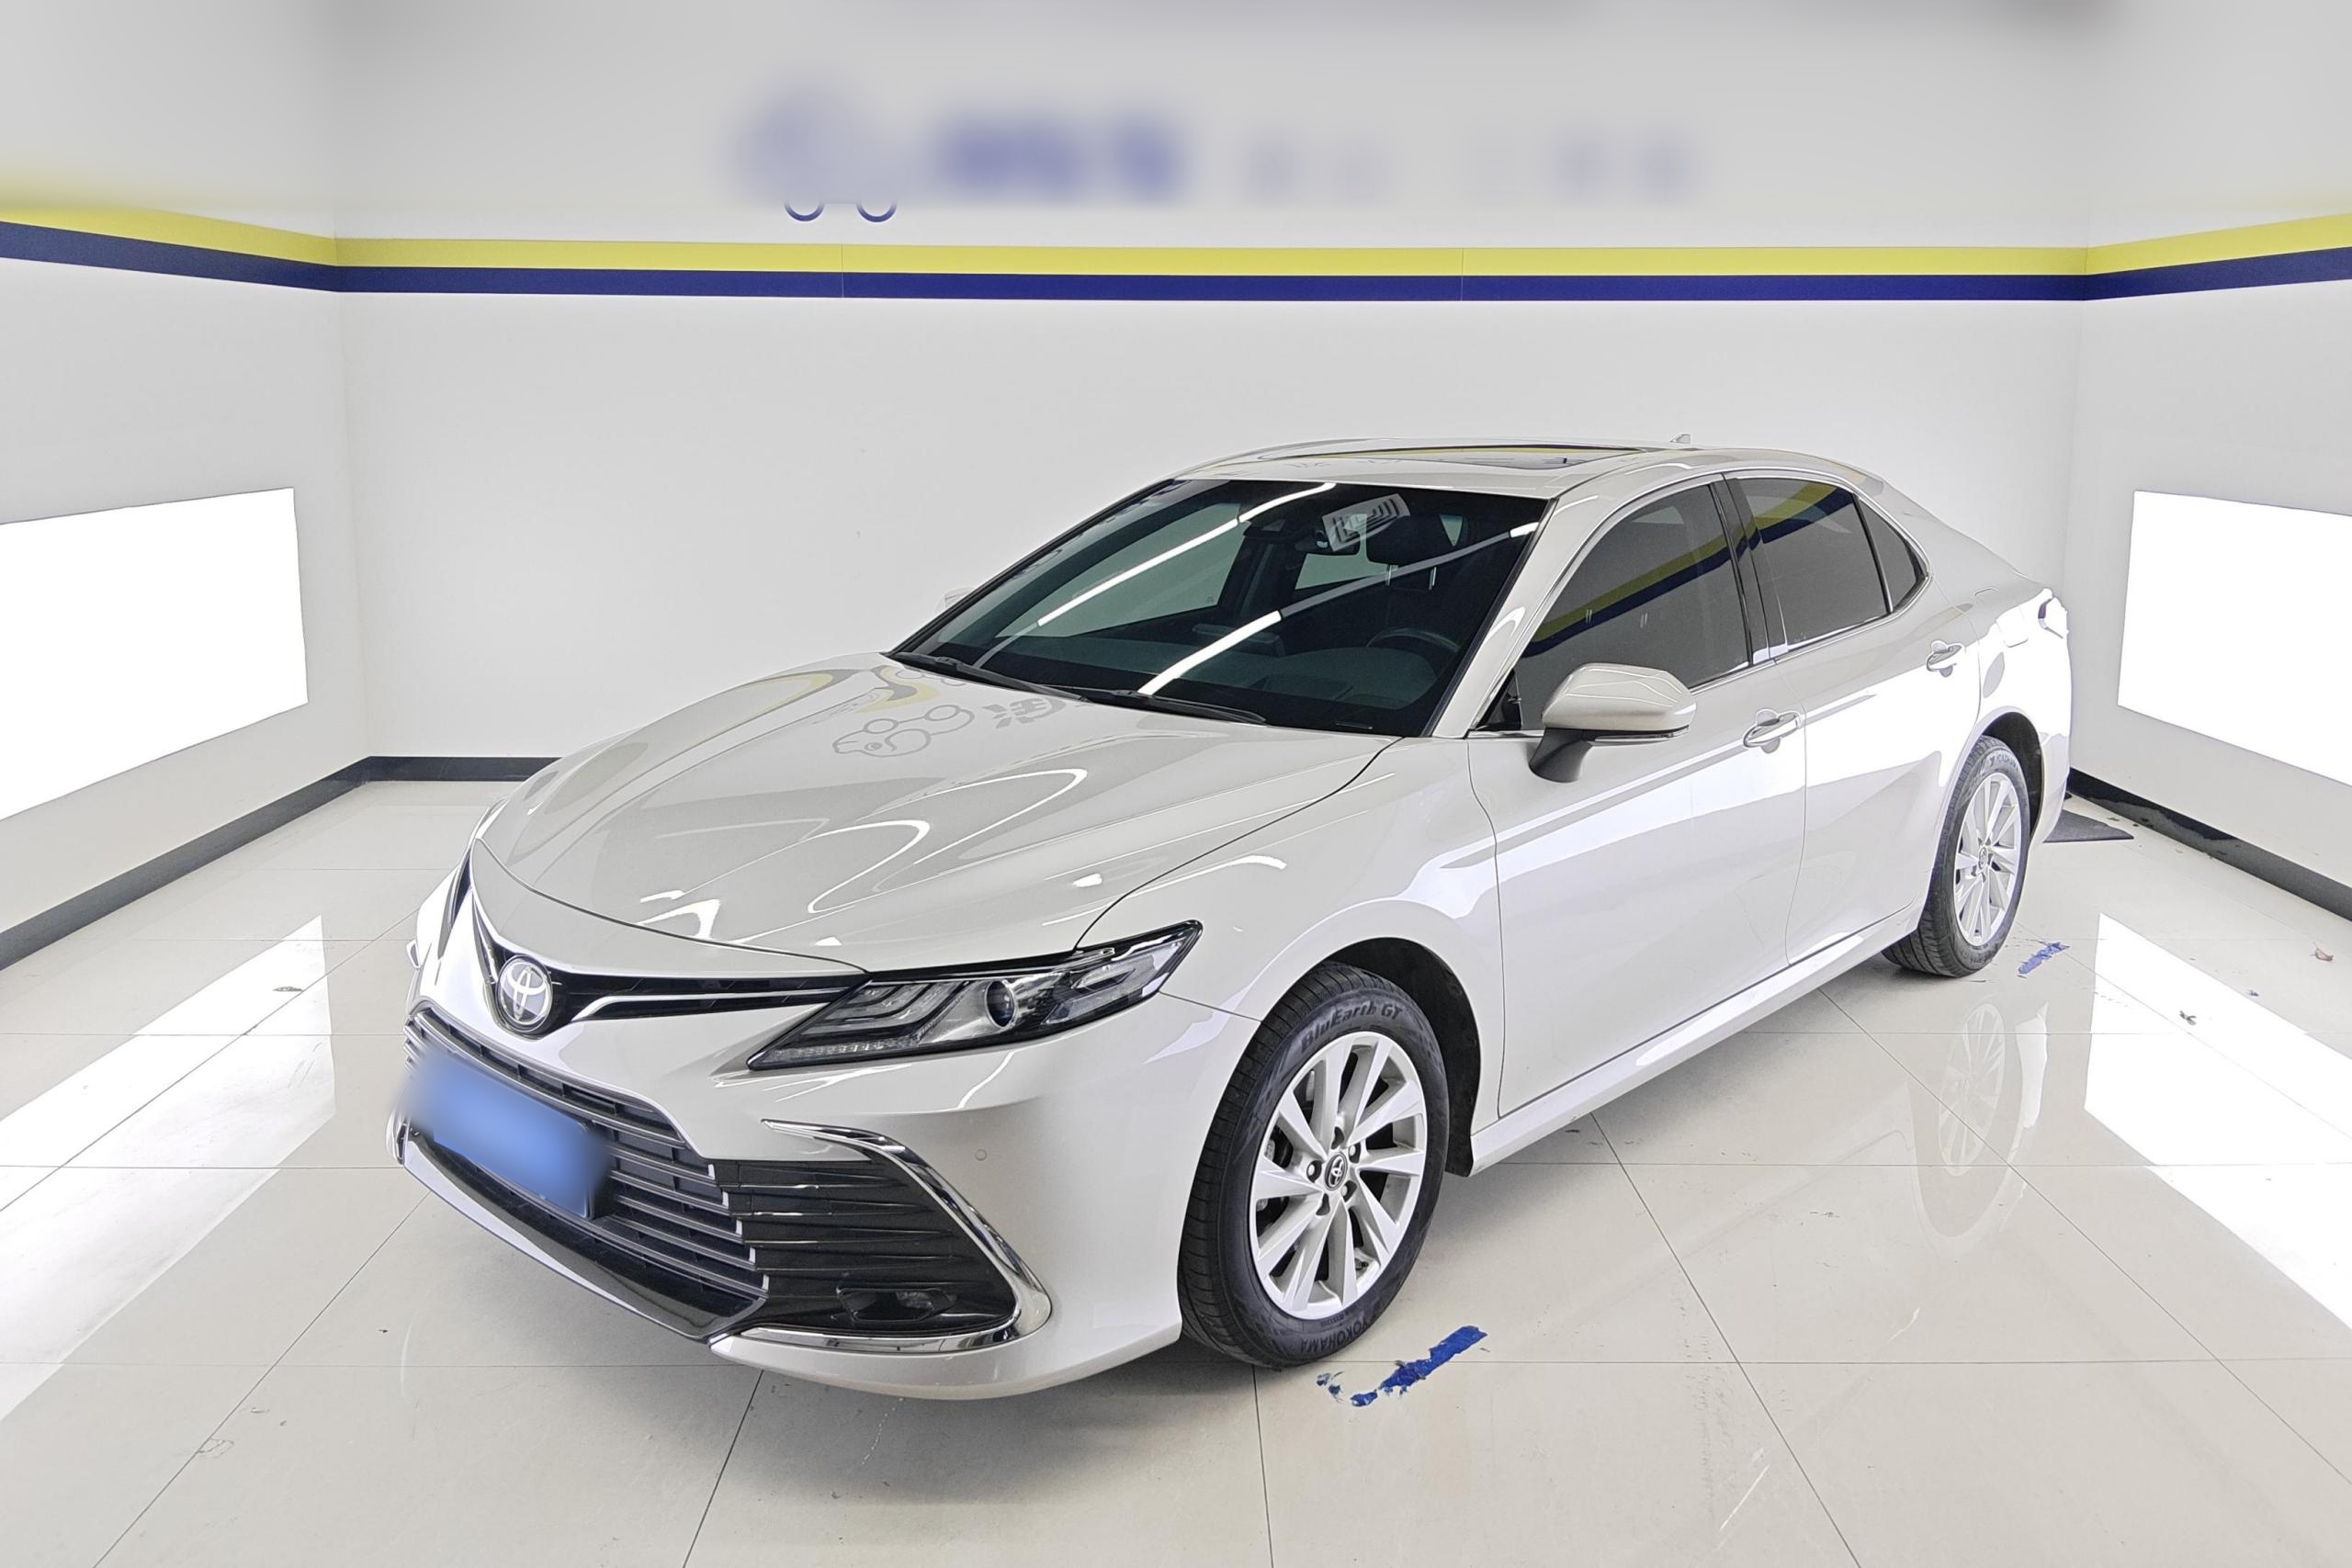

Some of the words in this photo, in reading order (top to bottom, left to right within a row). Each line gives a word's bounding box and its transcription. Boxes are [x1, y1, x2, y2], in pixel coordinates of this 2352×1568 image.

[1301, 1000, 1377, 1054] BluEarth
[1381, 1003, 1404, 1021] GT
[1300, 1317, 1369, 1353] YOKOHAMA
